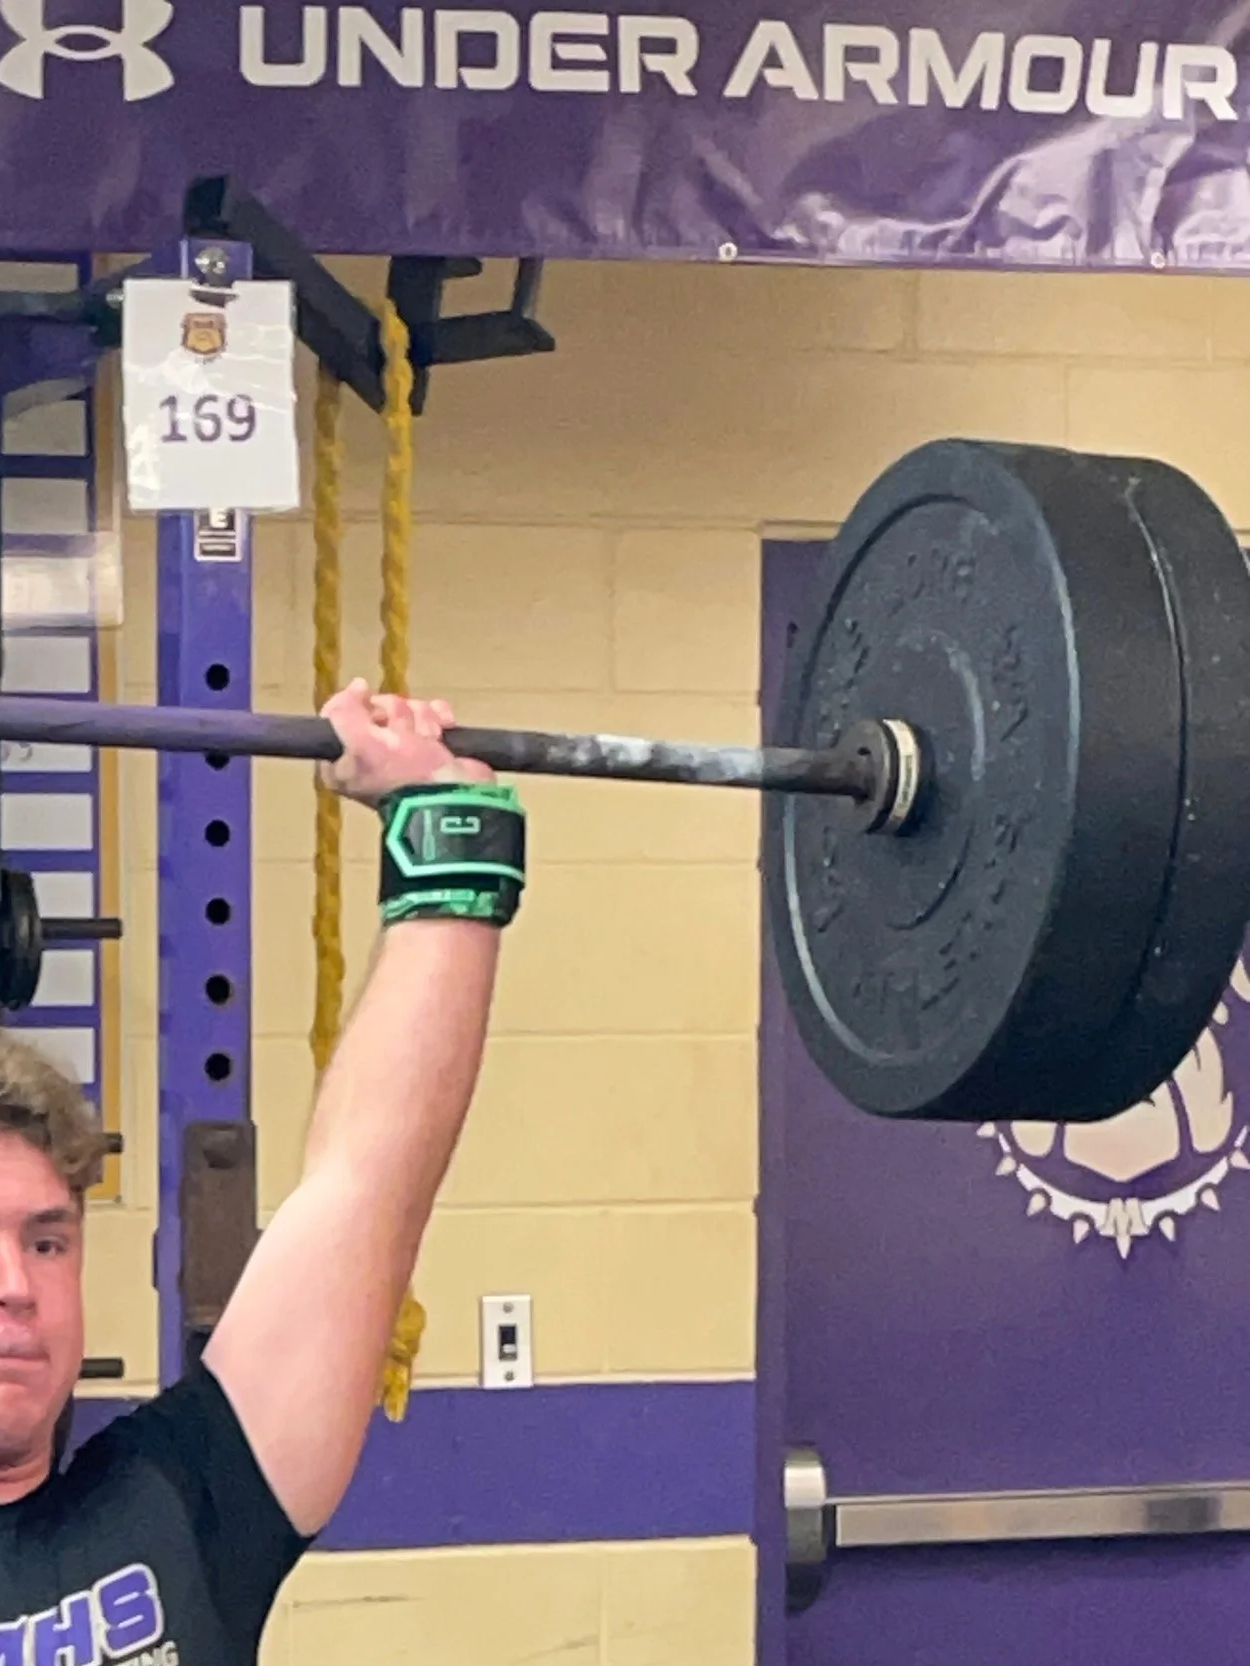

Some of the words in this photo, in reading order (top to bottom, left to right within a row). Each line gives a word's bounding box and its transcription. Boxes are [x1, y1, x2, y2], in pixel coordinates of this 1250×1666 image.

[240, 4, 700, 96] UNDER
[723, 20, 1238, 121] ARMOUR
[159, 394, 256, 443] 169
